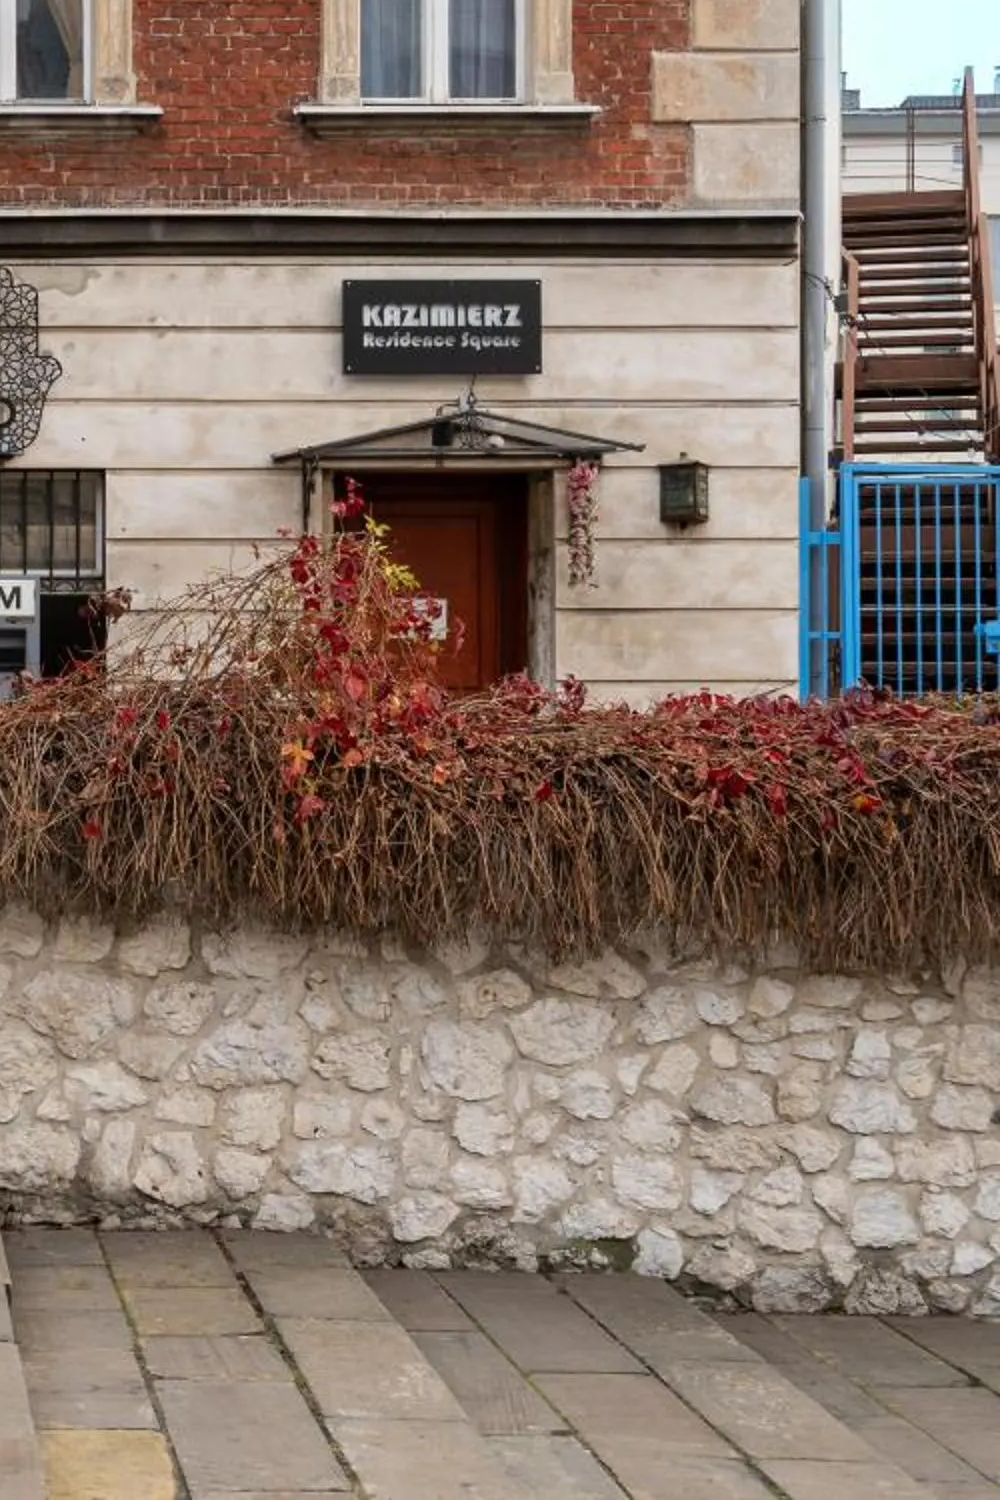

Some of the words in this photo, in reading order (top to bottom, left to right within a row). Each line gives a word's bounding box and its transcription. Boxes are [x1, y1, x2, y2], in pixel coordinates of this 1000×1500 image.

[362, 304, 523, 327] KAZIMIERZ
[363, 331, 456, 348] Residence
[461, 331, 521, 351] Square
